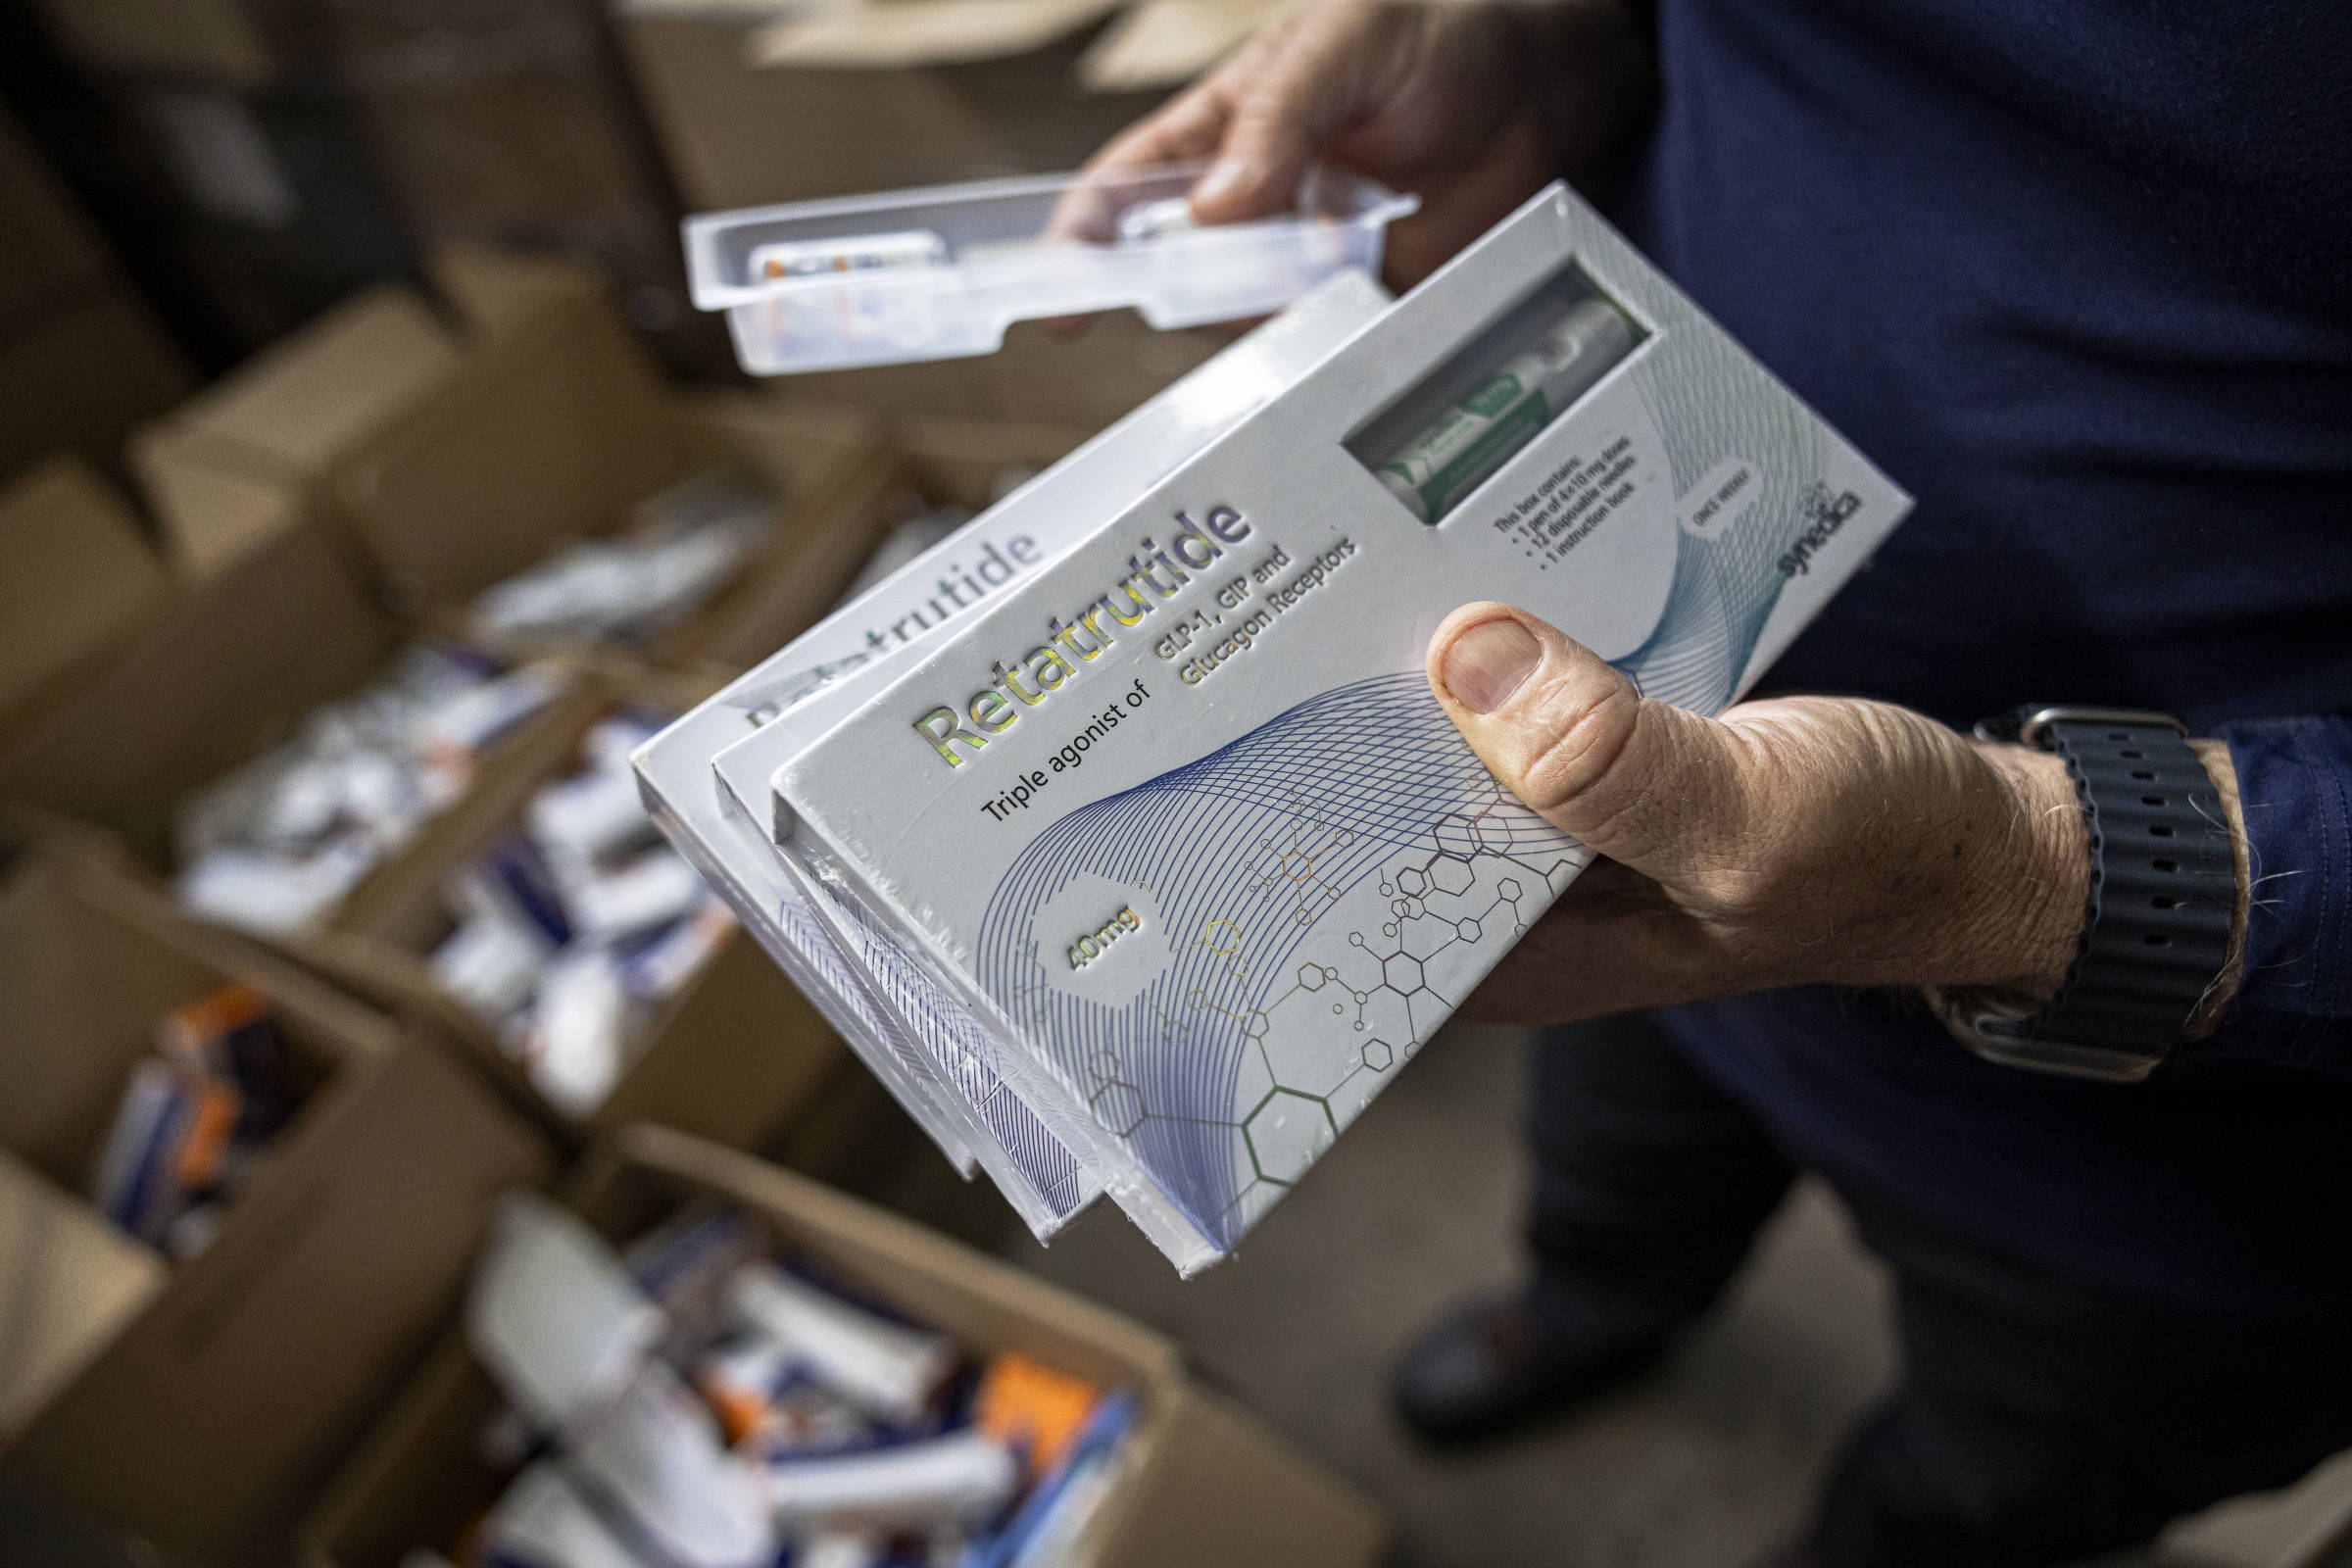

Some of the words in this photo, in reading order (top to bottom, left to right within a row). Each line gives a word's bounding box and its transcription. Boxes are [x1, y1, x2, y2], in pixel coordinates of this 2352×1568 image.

[1493, 510, 1521, 534] This
[1514, 492, 1541, 515] box
[1518, 525, 1531, 538] 1
[1528, 509, 1551, 533] pen
[1547, 495, 1562, 514] of
[1531, 531, 1551, 550] 12
[1547, 487, 1601, 538] disposable
[1544, 551, 1559, 564] 1
[1552, 504, 1610, 557] instruction
[1604, 480, 1636, 509] book
[912, 504, 1253, 768] Retatrutide
[1154, 609, 1222, 662] GLP-1,
[1216, 575, 1250, 610] GIP
[1252, 544, 1292, 585] and
[1180, 609, 1273, 686] Glucagon
[1266, 537, 1357, 613] Receptors
[980, 769, 1050, 822] Triple
[1048, 703, 1128, 773] agonist
[1125, 677, 1152, 709] of
[1065, 904, 1142, 973] 40mg
